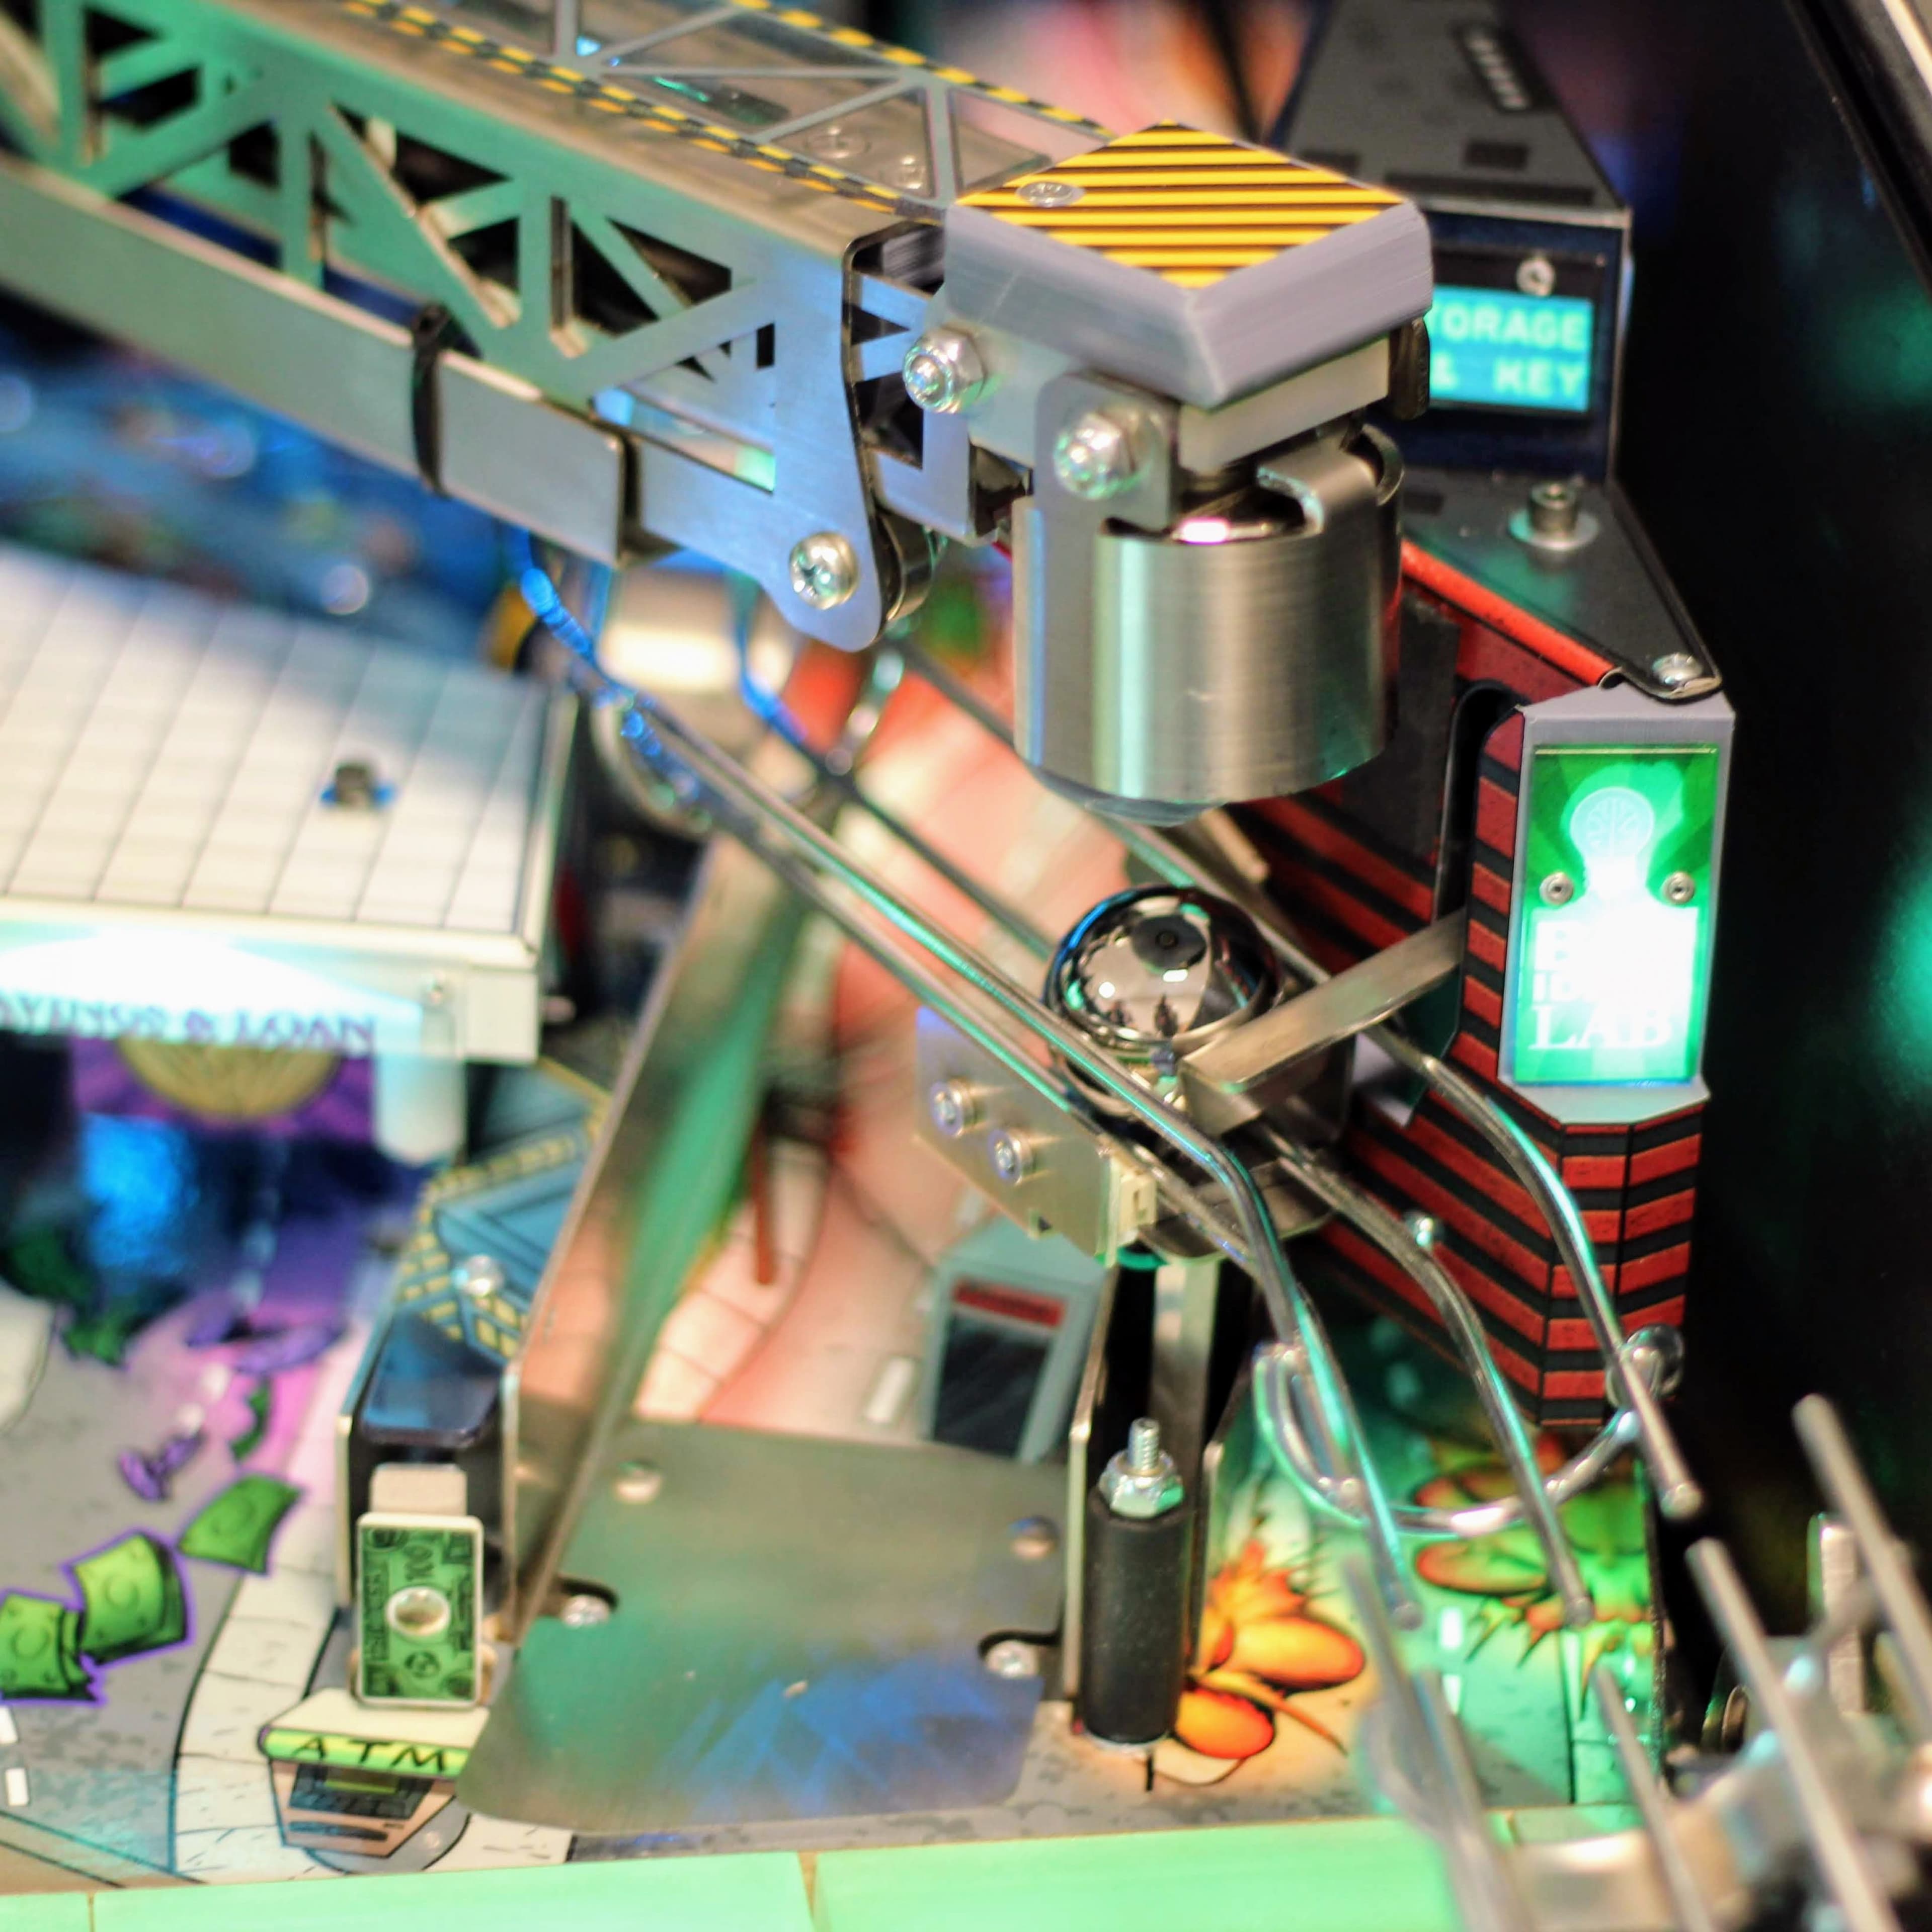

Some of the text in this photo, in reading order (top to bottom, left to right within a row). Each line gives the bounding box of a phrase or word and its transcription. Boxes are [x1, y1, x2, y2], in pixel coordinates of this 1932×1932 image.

[1494, 357, 1585, 397] KEY
[1528, 1006, 1673, 1050] LAB
[292, 1737, 445, 1773] ATM
